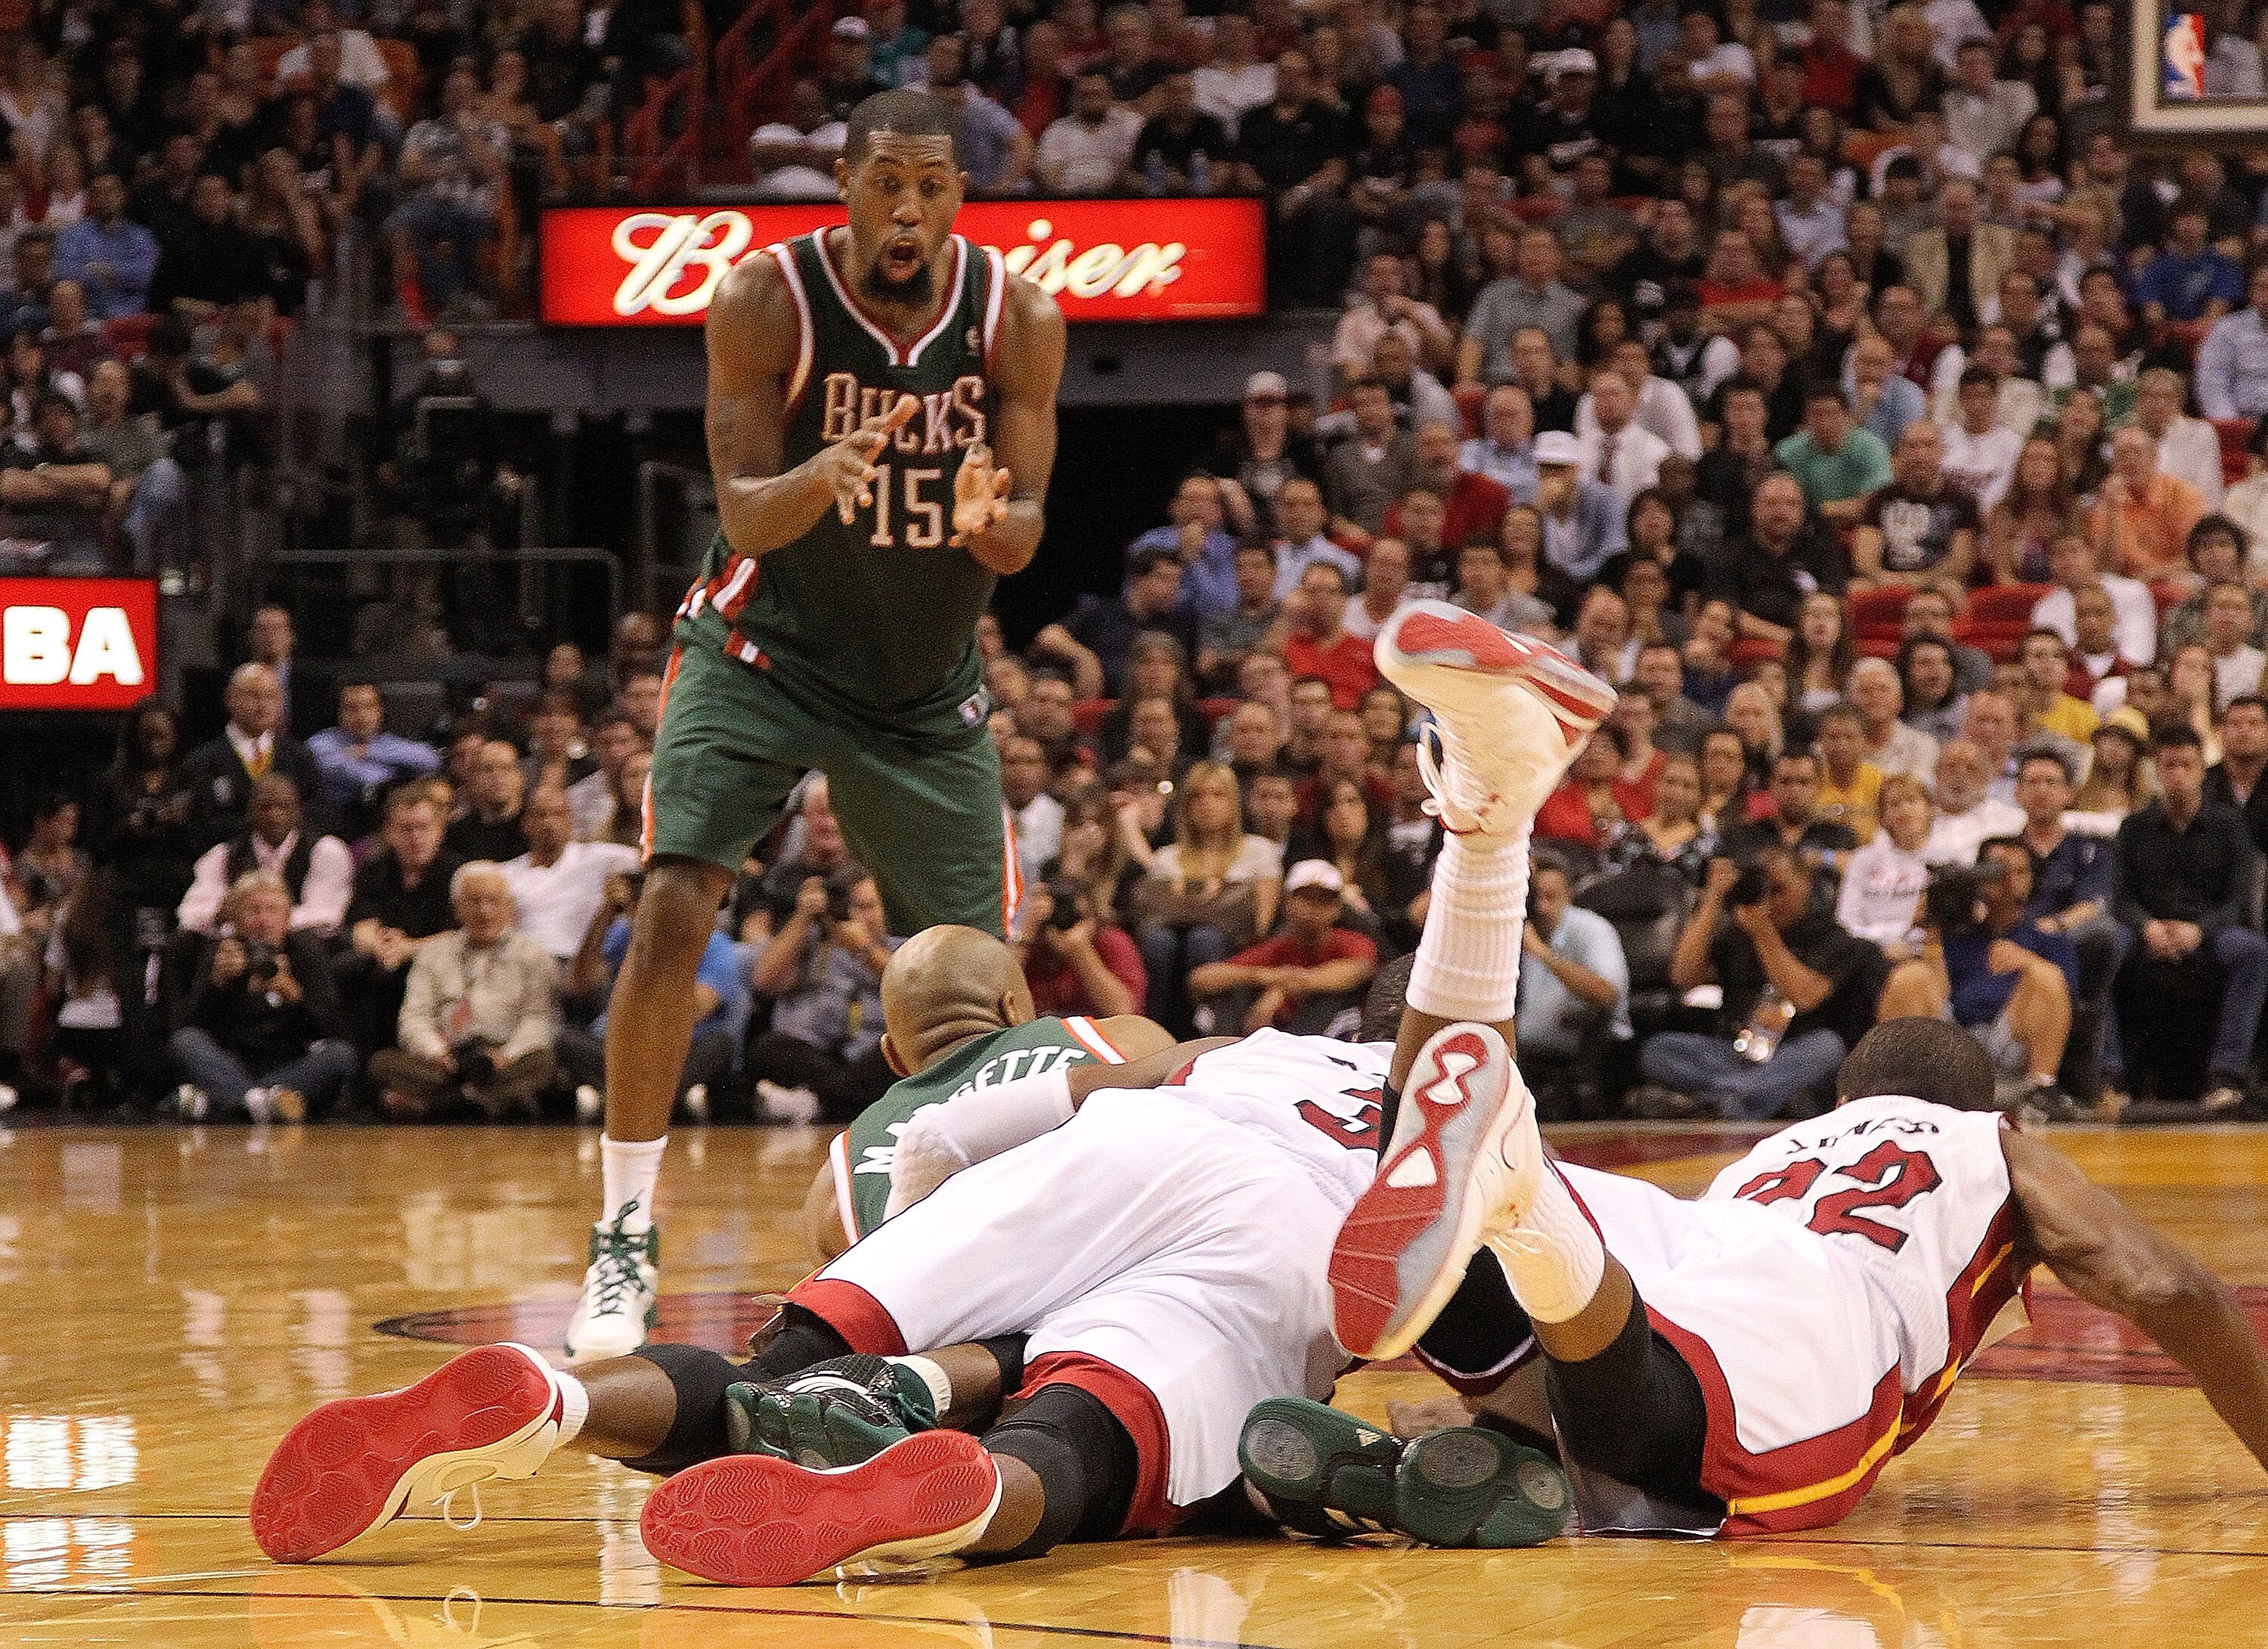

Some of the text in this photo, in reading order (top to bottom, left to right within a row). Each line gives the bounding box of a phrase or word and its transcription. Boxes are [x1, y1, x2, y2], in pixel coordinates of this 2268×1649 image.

[610, 209, 1186, 317] Biser
[869, 463, 943, 547] 15
[853, 1045, 1087, 1174] METTE
